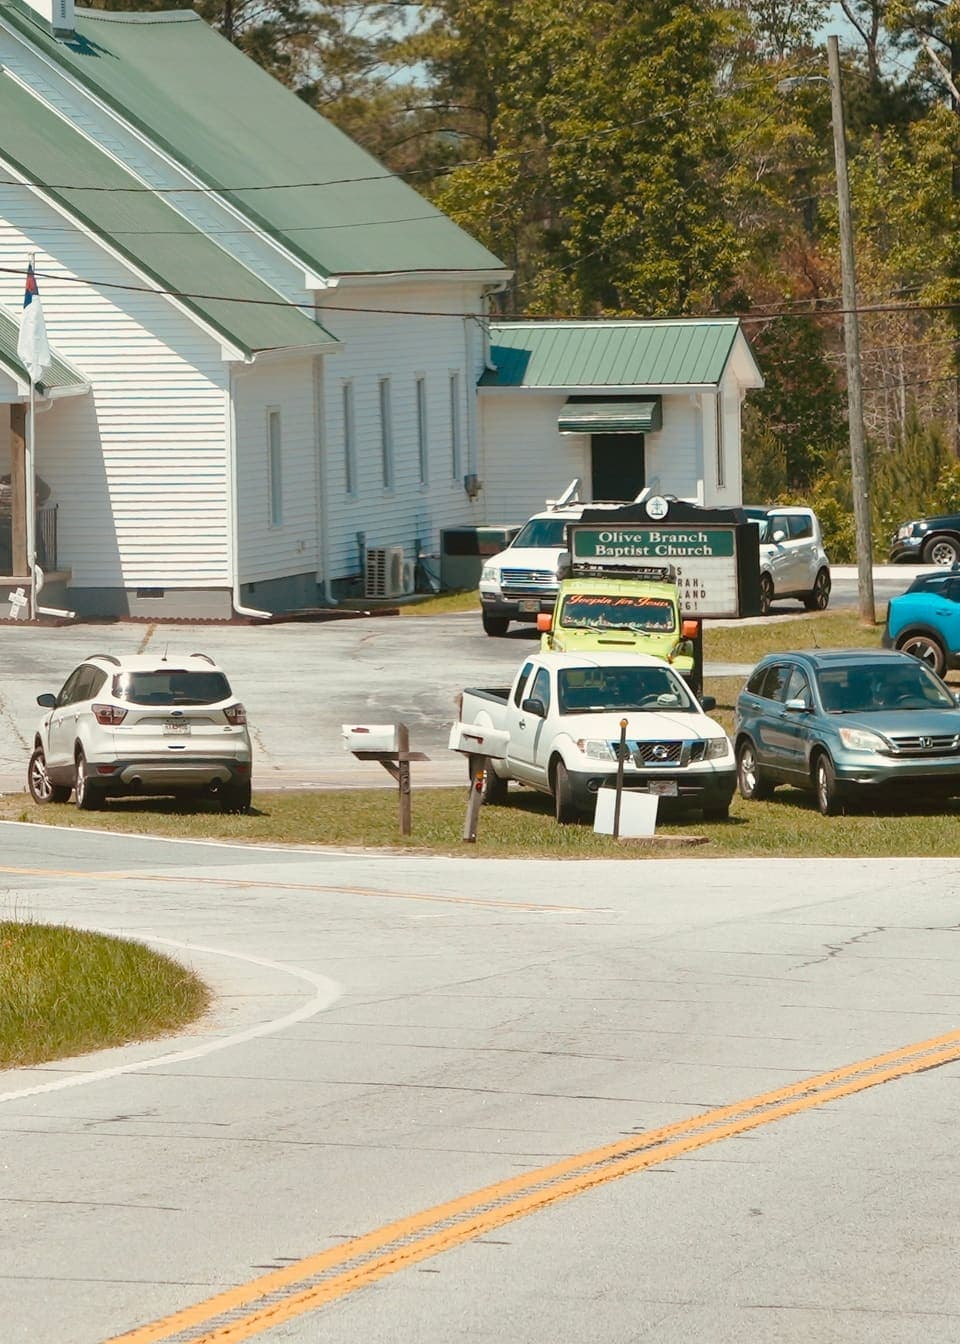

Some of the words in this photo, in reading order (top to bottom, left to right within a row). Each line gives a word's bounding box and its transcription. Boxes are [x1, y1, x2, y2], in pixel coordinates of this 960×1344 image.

[598, 531, 642, 543] Olive
[649, 531, 708, 543] Branch
[595, 544, 650, 557] Baptist
[655, 544, 713, 556] Church
[566, 595, 612, 606] Jeepin
[612, 597, 634, 606] for
[635, 597, 670, 607] Jesus
